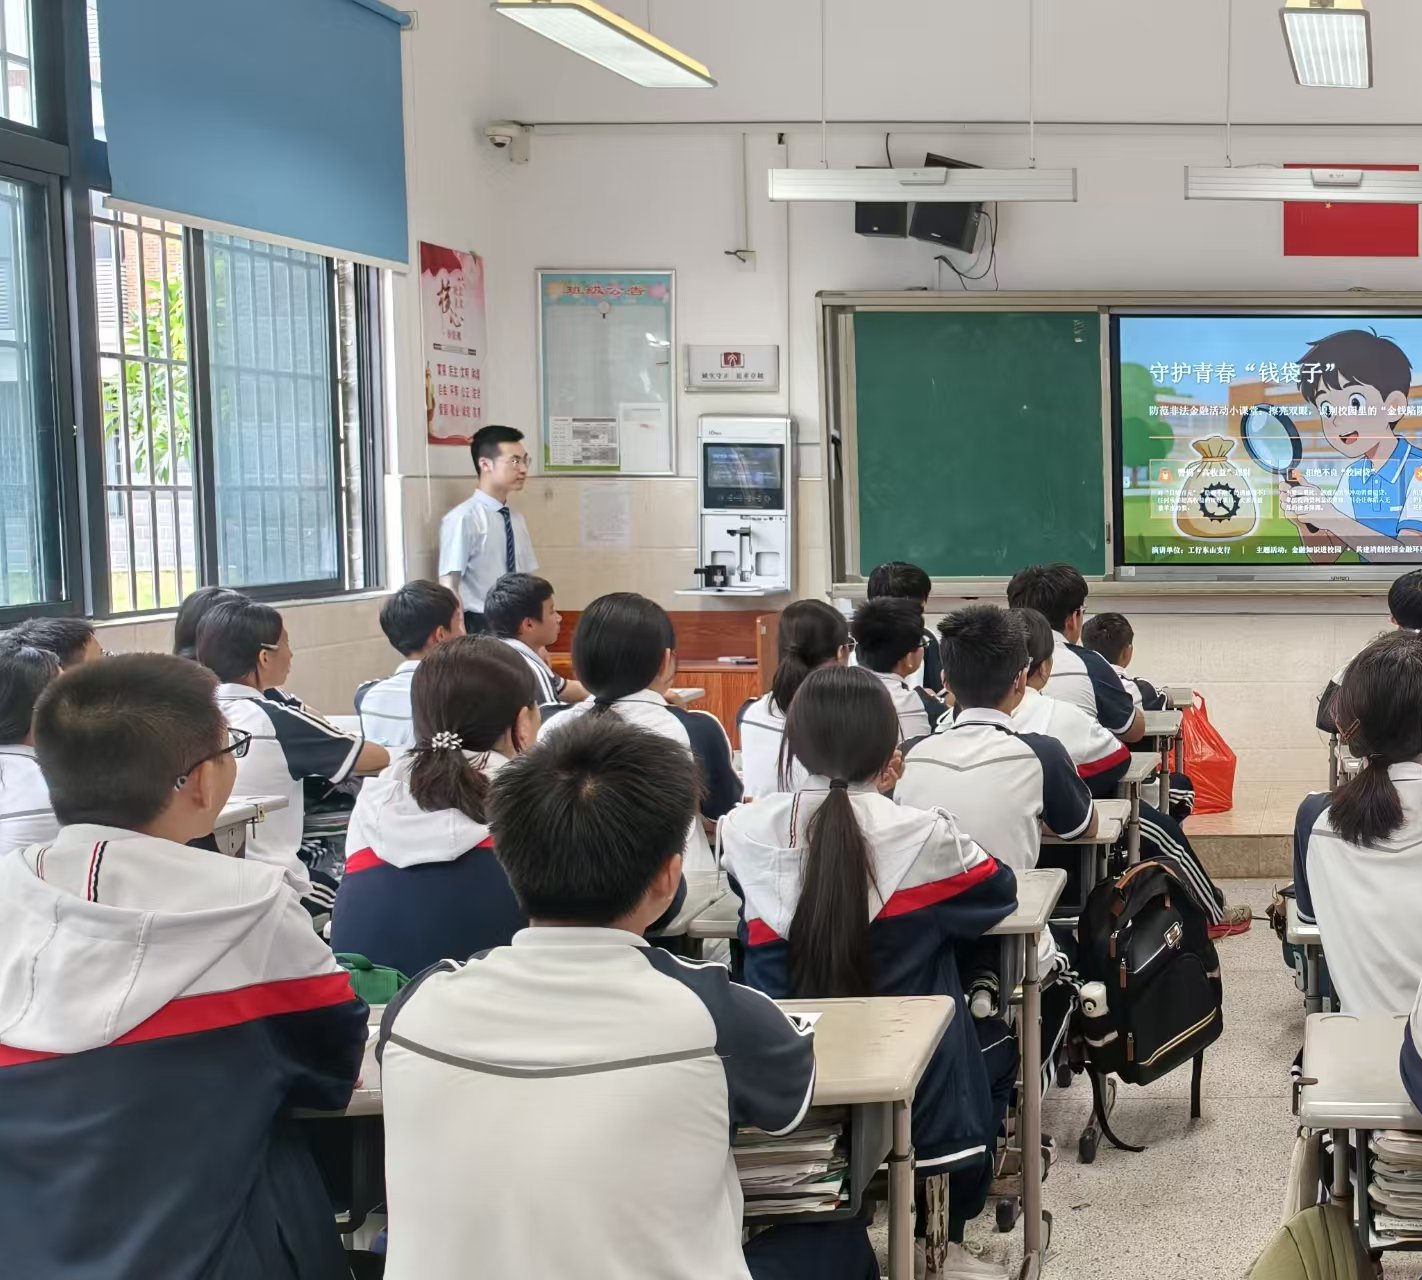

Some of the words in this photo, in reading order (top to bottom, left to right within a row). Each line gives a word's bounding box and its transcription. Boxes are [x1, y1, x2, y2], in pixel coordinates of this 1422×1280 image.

[564, 286, 646, 297] 班级公告
[1149, 361, 1336, 384] 守护青春“钱袋子”
